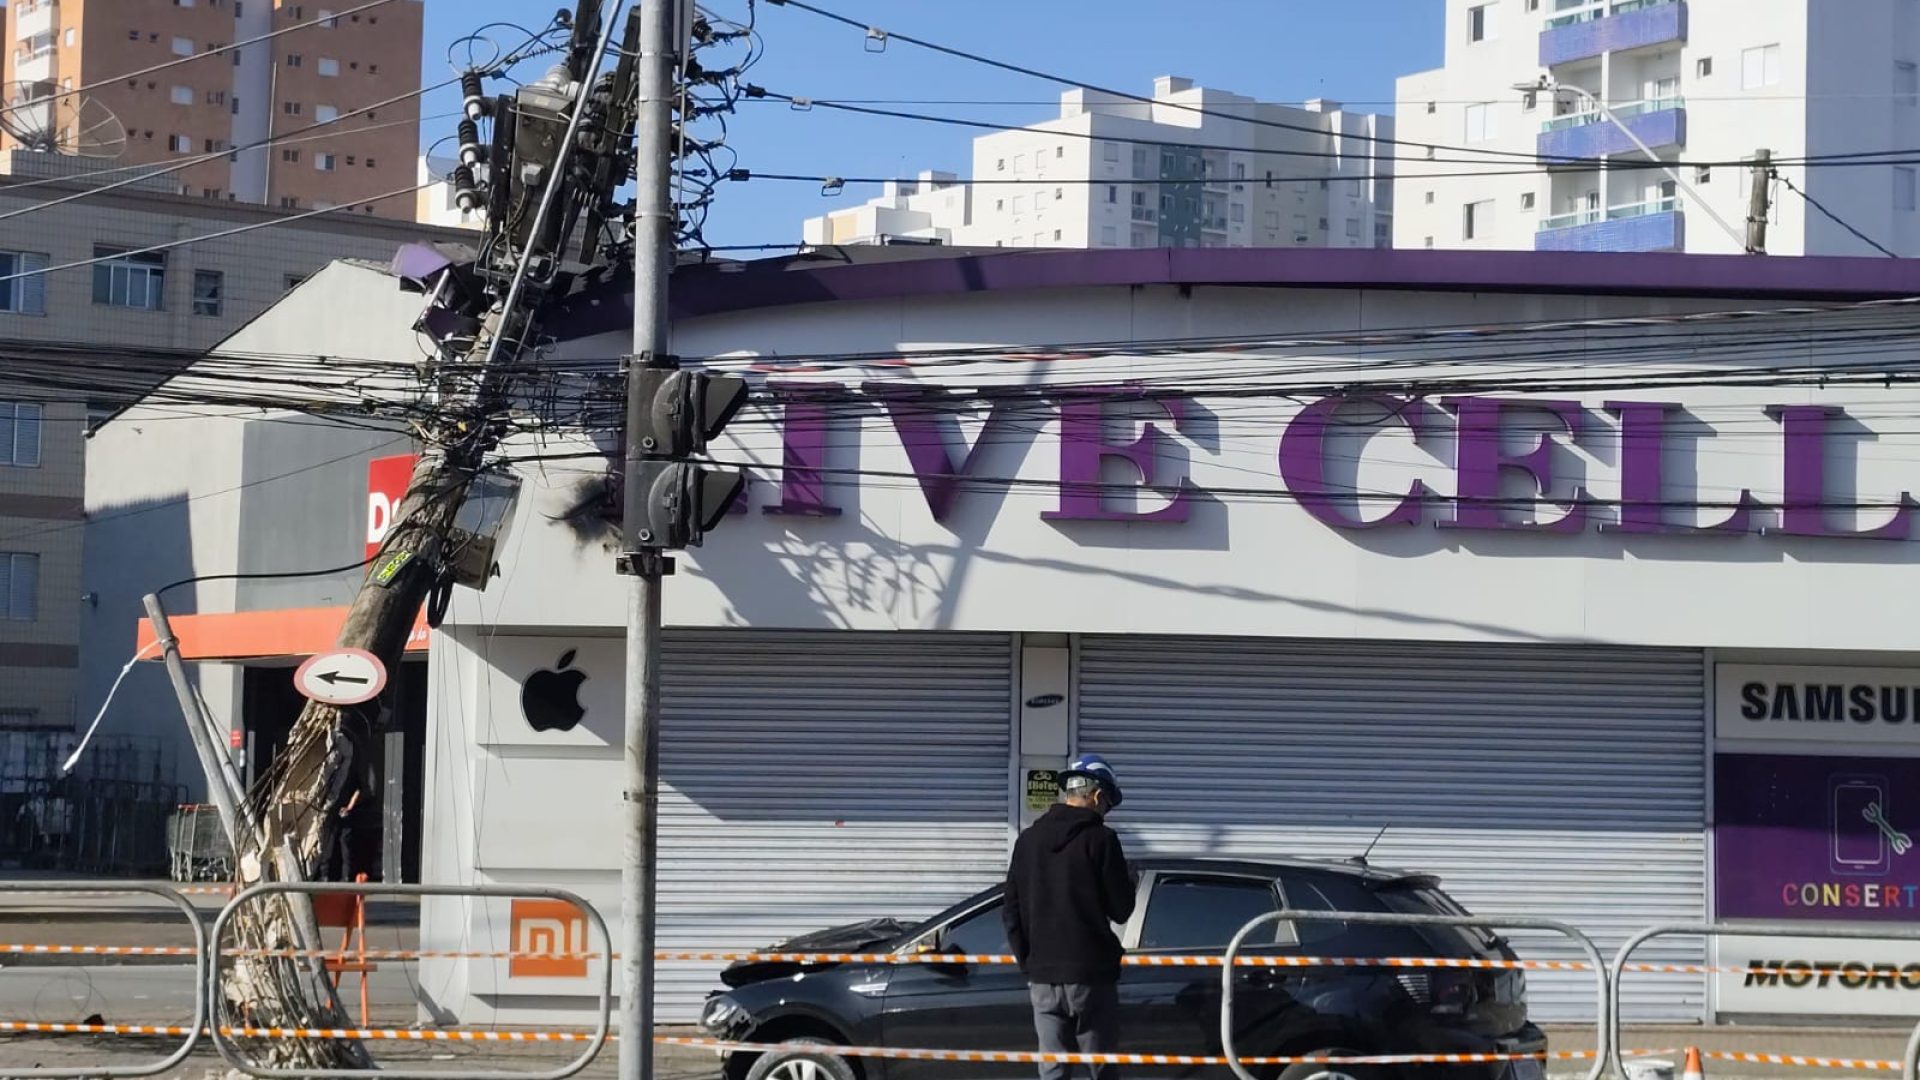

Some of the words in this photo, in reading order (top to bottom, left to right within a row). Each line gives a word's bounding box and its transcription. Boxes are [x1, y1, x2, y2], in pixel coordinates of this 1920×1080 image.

[612, 379, 1190, 523] IVE
[1278, 394, 1910, 537] CELL
[1741, 681, 1920, 725] SAMSU
